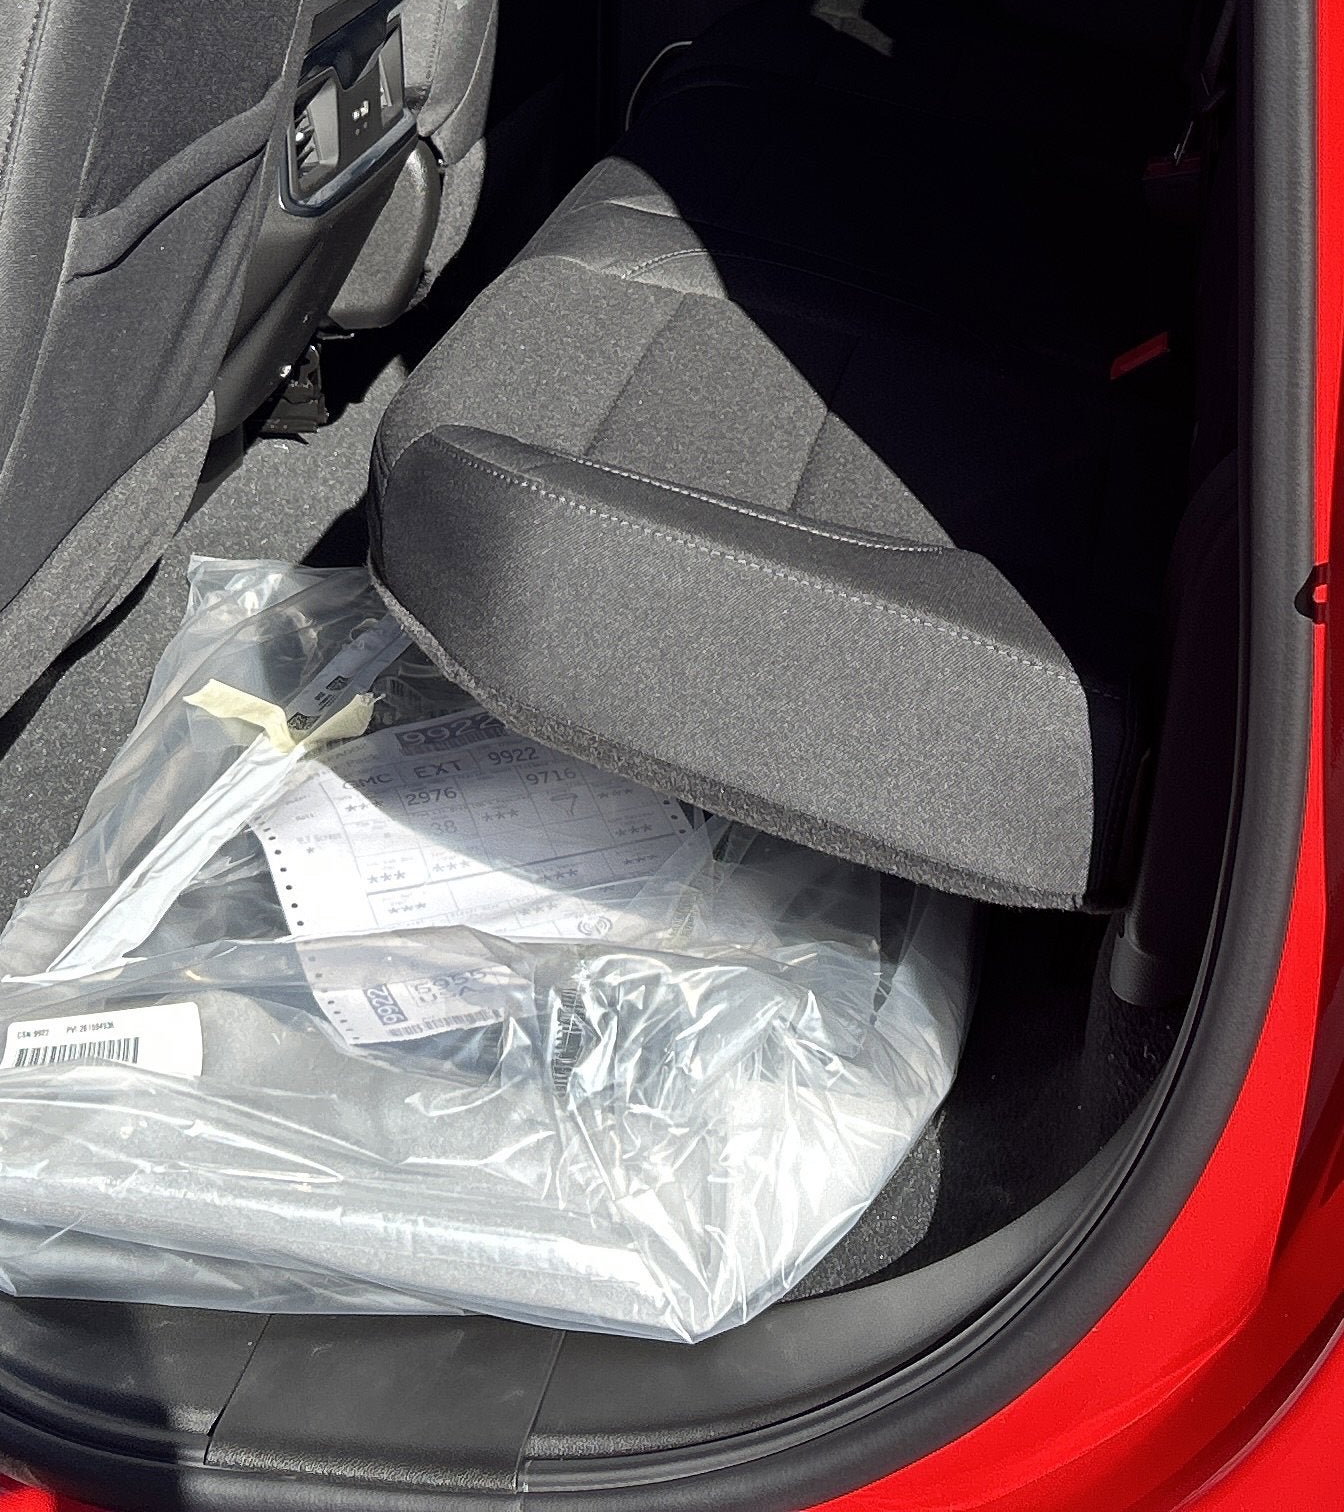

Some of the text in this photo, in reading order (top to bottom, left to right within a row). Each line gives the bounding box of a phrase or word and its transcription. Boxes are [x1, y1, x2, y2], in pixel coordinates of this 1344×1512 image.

[401, 712, 501, 746] 9922
[342, 746, 540, 790] GMC EXT 9922
[405, 767, 578, 807] 2976 9716
[366, 984, 405, 1024] 9922
